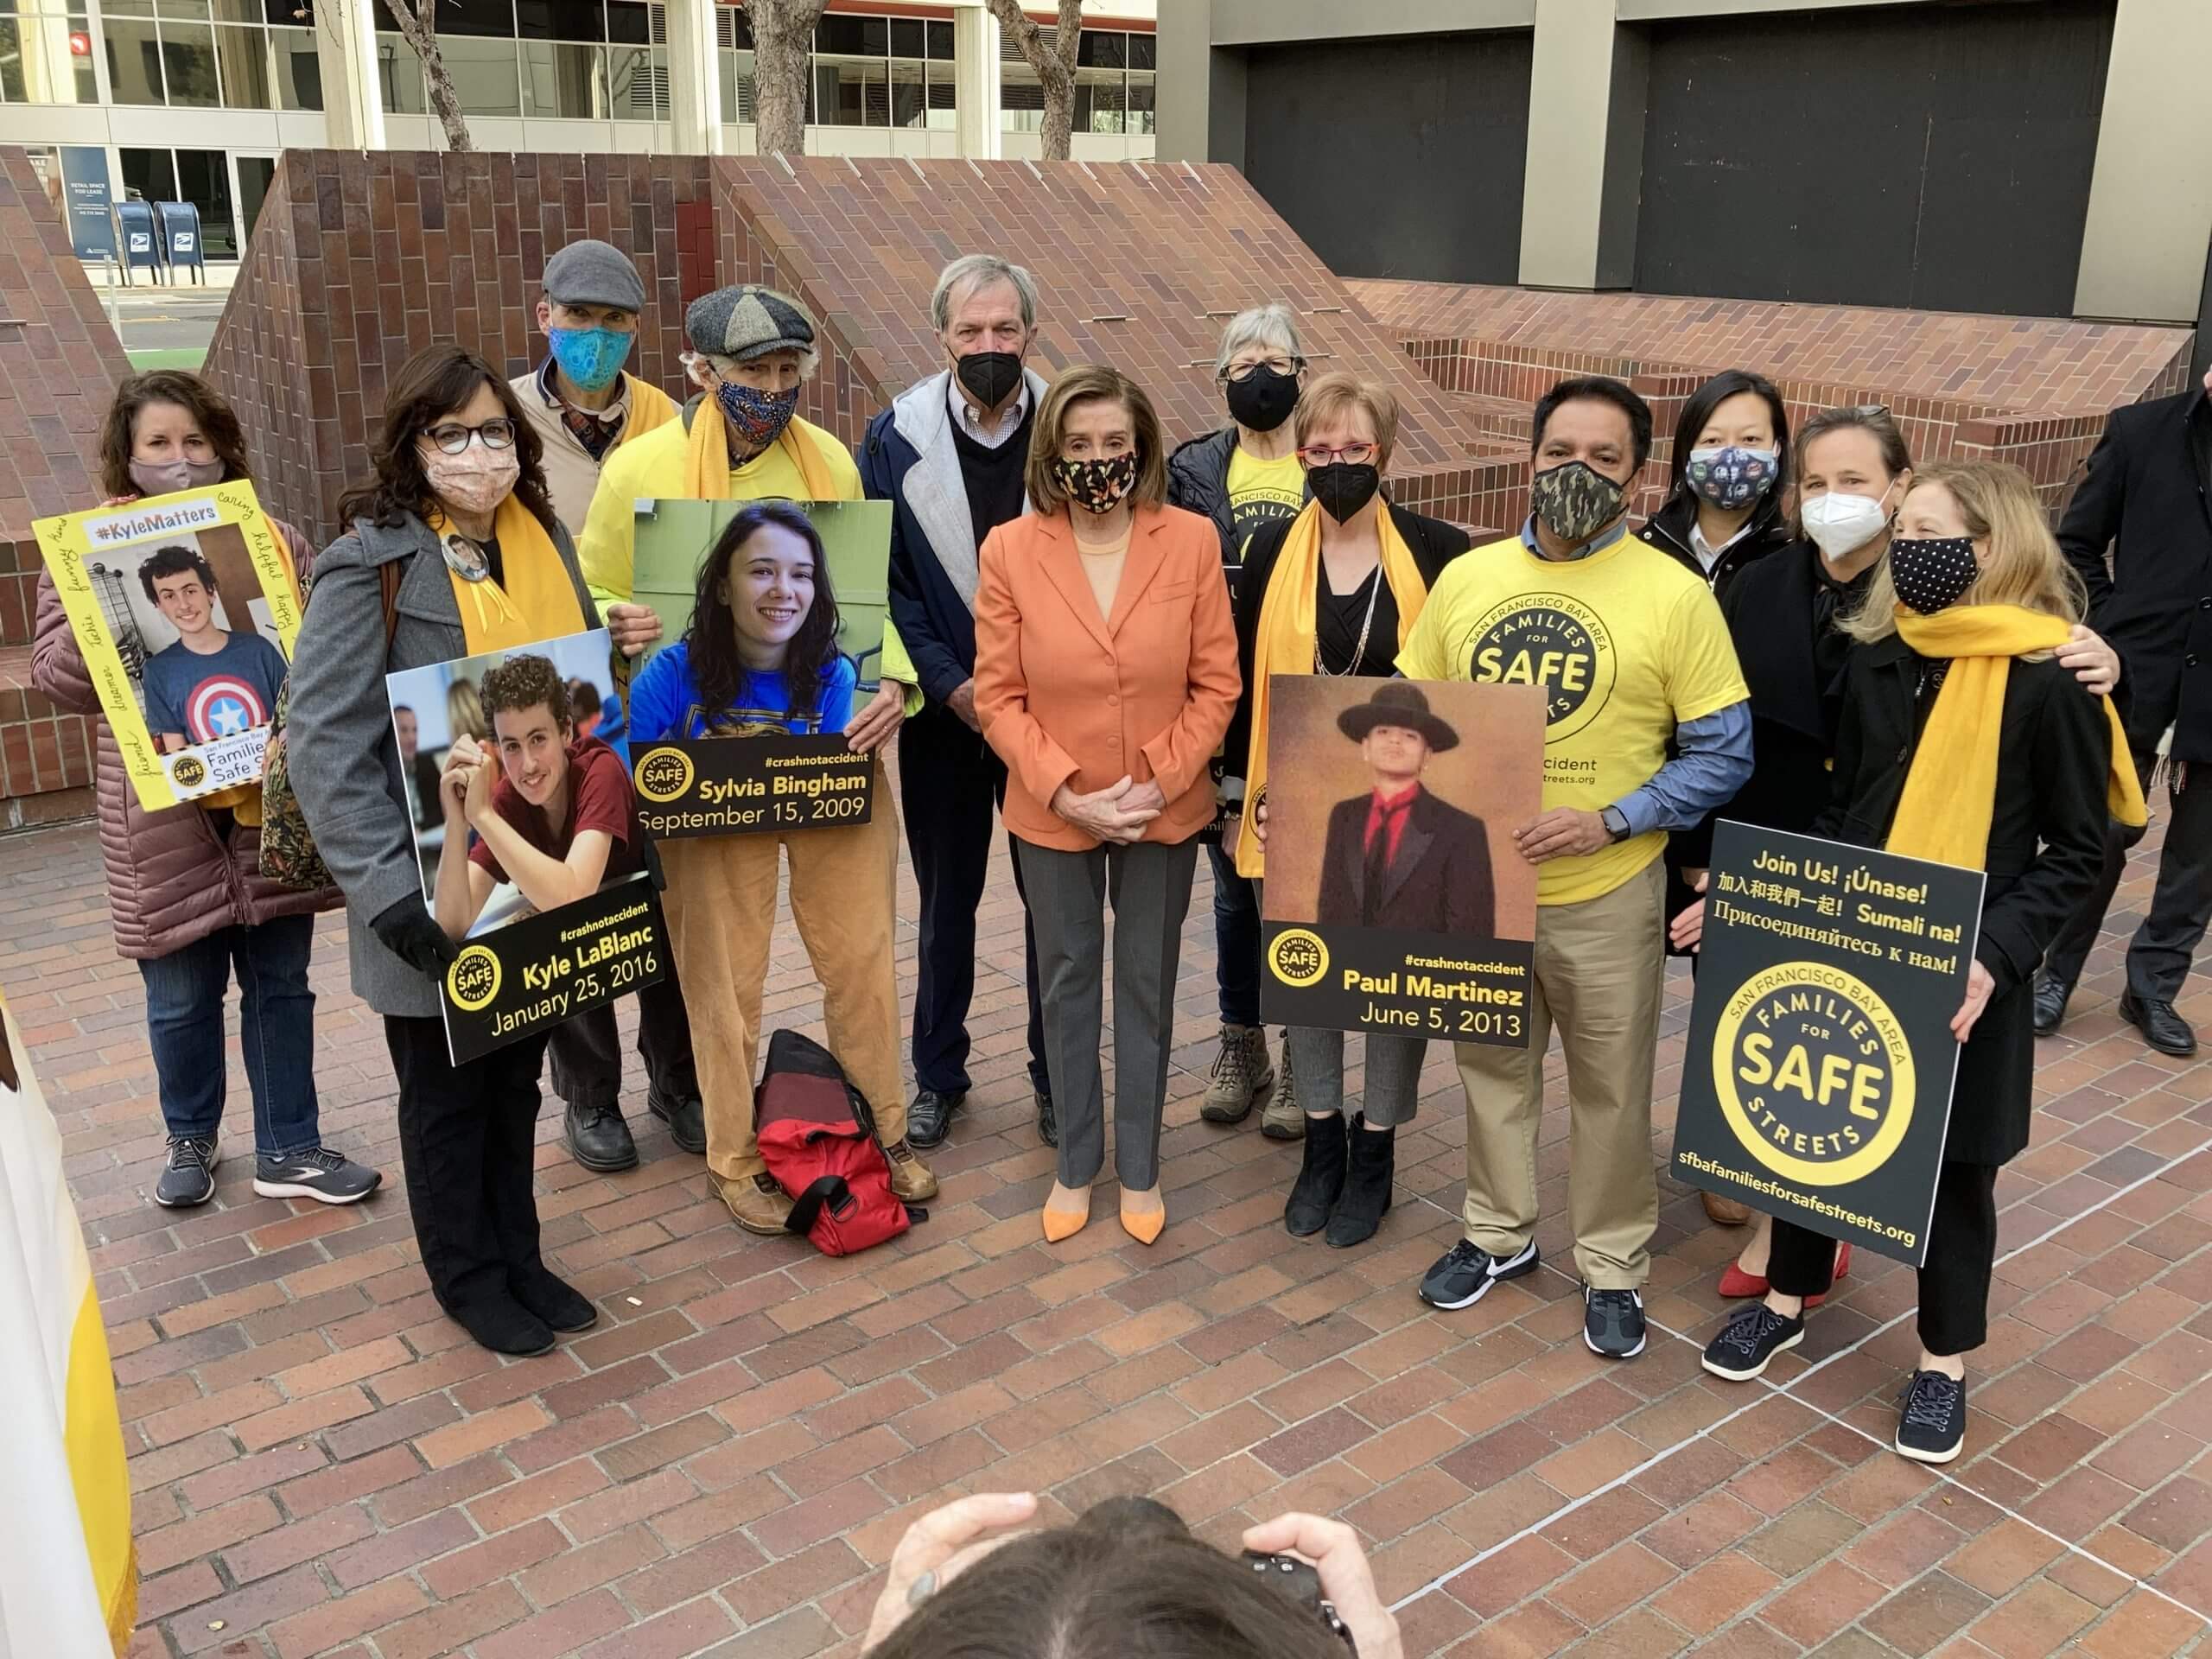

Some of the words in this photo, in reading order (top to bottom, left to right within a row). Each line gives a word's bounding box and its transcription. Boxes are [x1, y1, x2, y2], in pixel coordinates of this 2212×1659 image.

[96, 506, 216, 540] #KyleMatters
[217, 492, 255, 520] caring
[48, 518, 67, 543] kind
[59, 549, 90, 592] funny
[251, 531, 283, 581] helpful
[276, 594, 295, 630] happy
[1469, 622, 1491, 645] SAN
[1490, 597, 1564, 623] FRANCISCO
[1566, 604, 1591, 621] BAY
[1587, 620, 1609, 652] AREA
[1490, 613, 1586, 649] FAMILIES
[1526, 633, 1549, 645] FOR
[1475, 647, 1589, 692] SAFE
[175, 765, 203, 780] SAFE
[207, 743, 264, 767] Familie
[213, 763, 251, 782] Safe
[766, 753, 869, 768] #crashnotaccident
[645, 768, 683, 783] SAFE
[699, 778, 766, 804] Sylvia
[773, 772, 867, 798] Bingham
[639, 804, 765, 836] September
[773, 801, 804, 823] 15,
[811, 797, 865, 819] 2009
[1752, 849, 1797, 878] Join
[1803, 859, 1840, 886] Us!
[1844, 865, 1929, 905] ¡Únase!
[560, 901, 649, 943] #crashnotaccident
[1713, 899, 1883, 957] Присоединяйтесь
[1887, 945, 1902, 963] к
[1908, 952, 1958, 975] нам!
[1856, 904, 1924, 936] Sumali
[1929, 924, 1962, 944] na!
[523, 955, 572, 991] Kyle
[576, 926, 653, 969] LaBlanc
[1279, 950, 1319, 967] SAFE
[1404, 954, 1526, 976] #crashnotaccident
[457, 966, 493, 992] SAFE
[491, 990, 569, 1037] January
[574, 973, 606, 1002] 25,
[610, 950, 658, 988] 2016
[1344, 969, 1398, 995] Paul
[1406, 975, 1524, 1007] Martinez
[1360, 1001, 1420, 1027] June
[1427, 1007, 1450, 1033] 5,
[1459, 1009, 1522, 1037] 2013
[1731, 988, 1756, 1020] SAN
[1756, 968, 1847, 994] FRANCISCO
[1849, 986, 1881, 1014] BAY
[1877, 1018, 1907, 1066] AREA
[1756, 992, 1879, 1057] FAMILIES
[1801, 1022, 1831, 1040] FOR
[1738, 1032, 1885, 1121] SAFE
[1748, 1096, 1860, 1155] STREETS
[1678, 1152, 1916, 1249] sfbafamiliesforsafestreets.org
